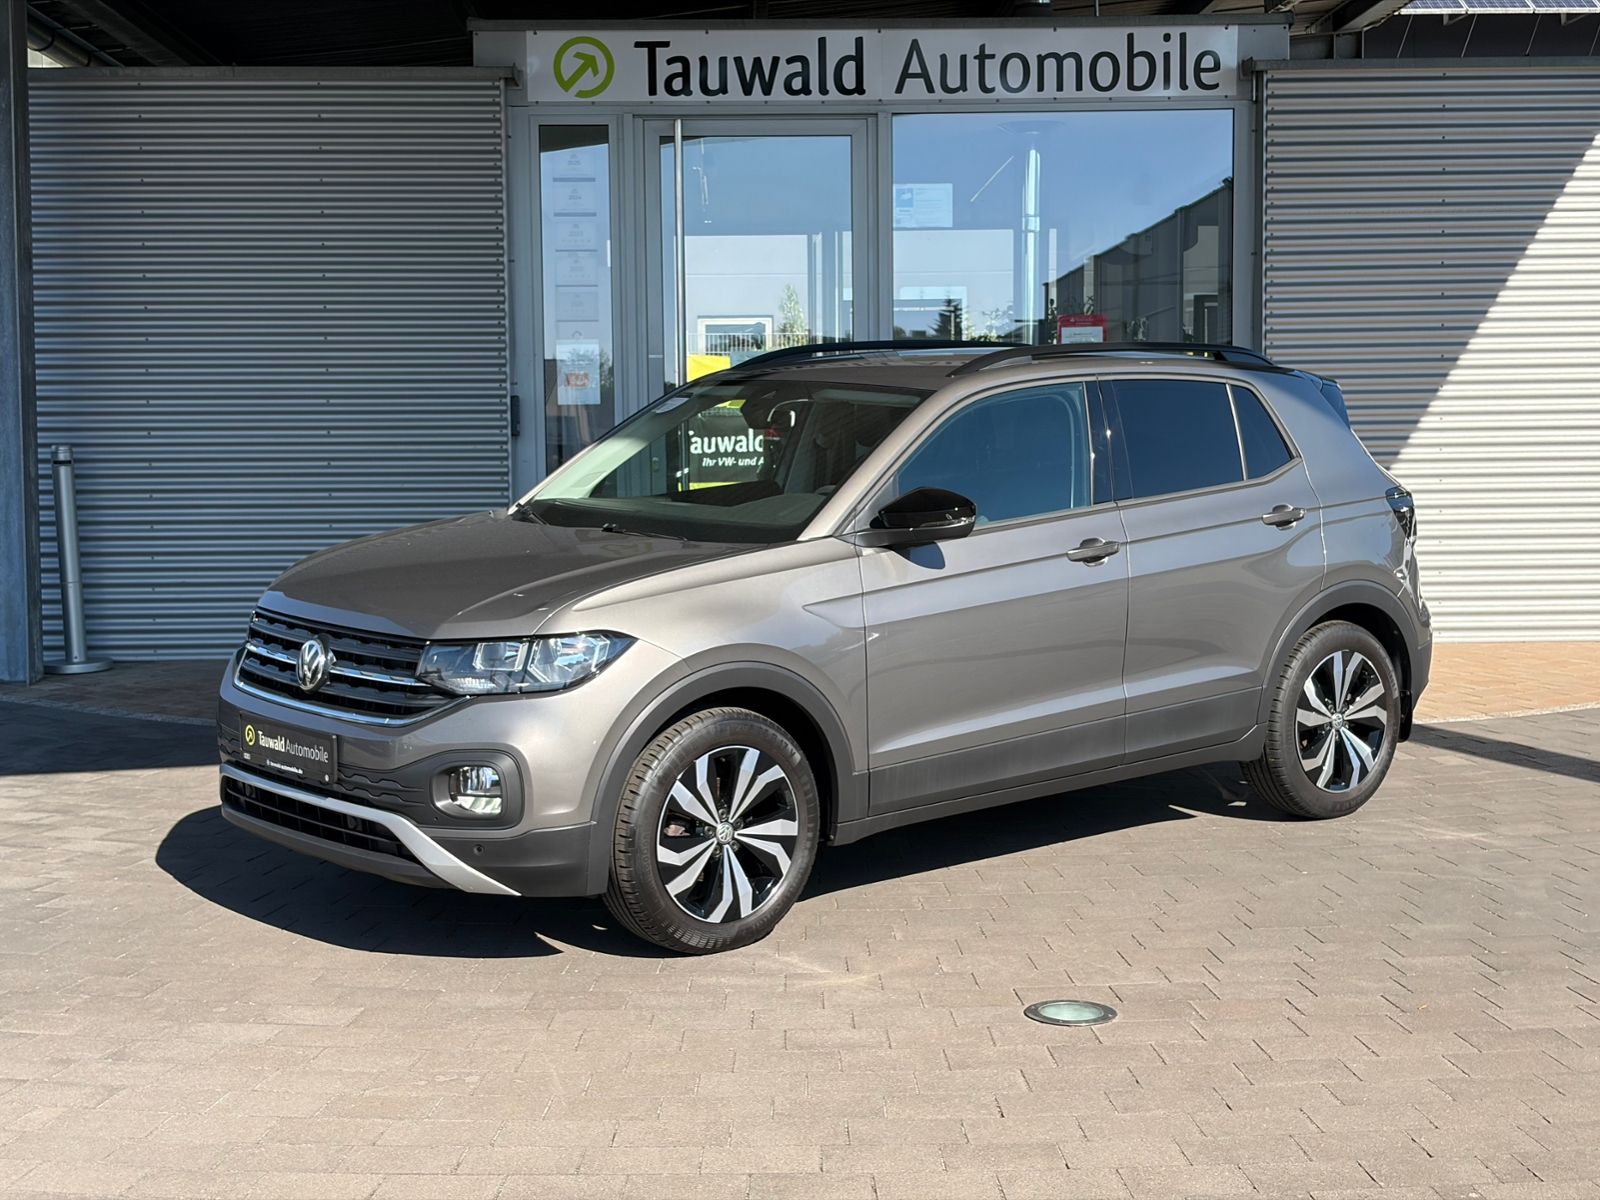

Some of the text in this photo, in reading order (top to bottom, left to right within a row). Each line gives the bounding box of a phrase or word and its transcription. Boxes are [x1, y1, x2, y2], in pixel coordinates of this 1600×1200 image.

[633, 32, 1221, 97] Tauwald Automobile
[688, 428, 764, 453] auwal
[702, 458, 717, 467] Ihr
[739, 457, 757, 466] und
[257, 730, 329, 763] Tauwald Automobile
